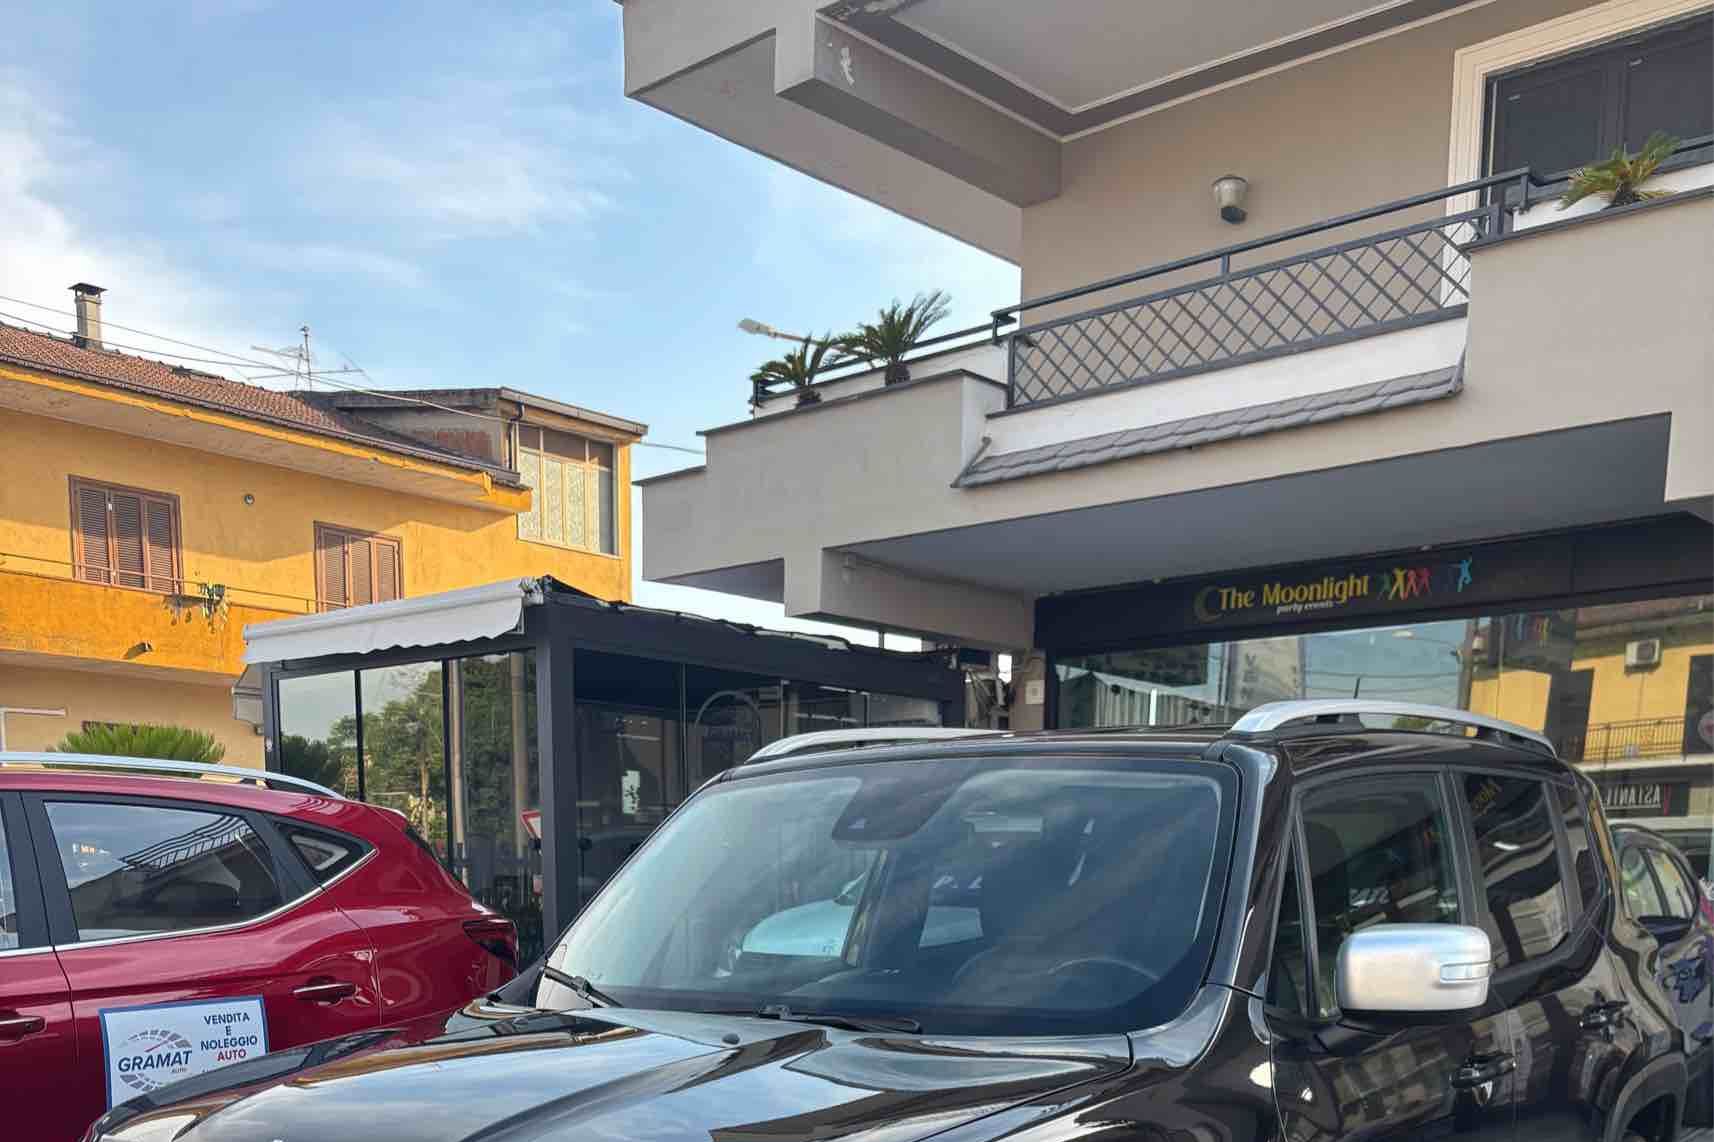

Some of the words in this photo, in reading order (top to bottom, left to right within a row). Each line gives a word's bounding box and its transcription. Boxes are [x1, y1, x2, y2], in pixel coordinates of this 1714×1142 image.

[1218, 588, 1254, 610] The
[1263, 575, 1369, 606] Moonlight
[1277, 602, 1303, 616] party
[204, 1012, 250, 1025] VENDITA
[225, 1025, 232, 1036] E
[200, 1035, 258, 1051] NOLEGGIO
[118, 1050, 193, 1073] GRAMAT
[217, 1048, 247, 1062] AUTO
